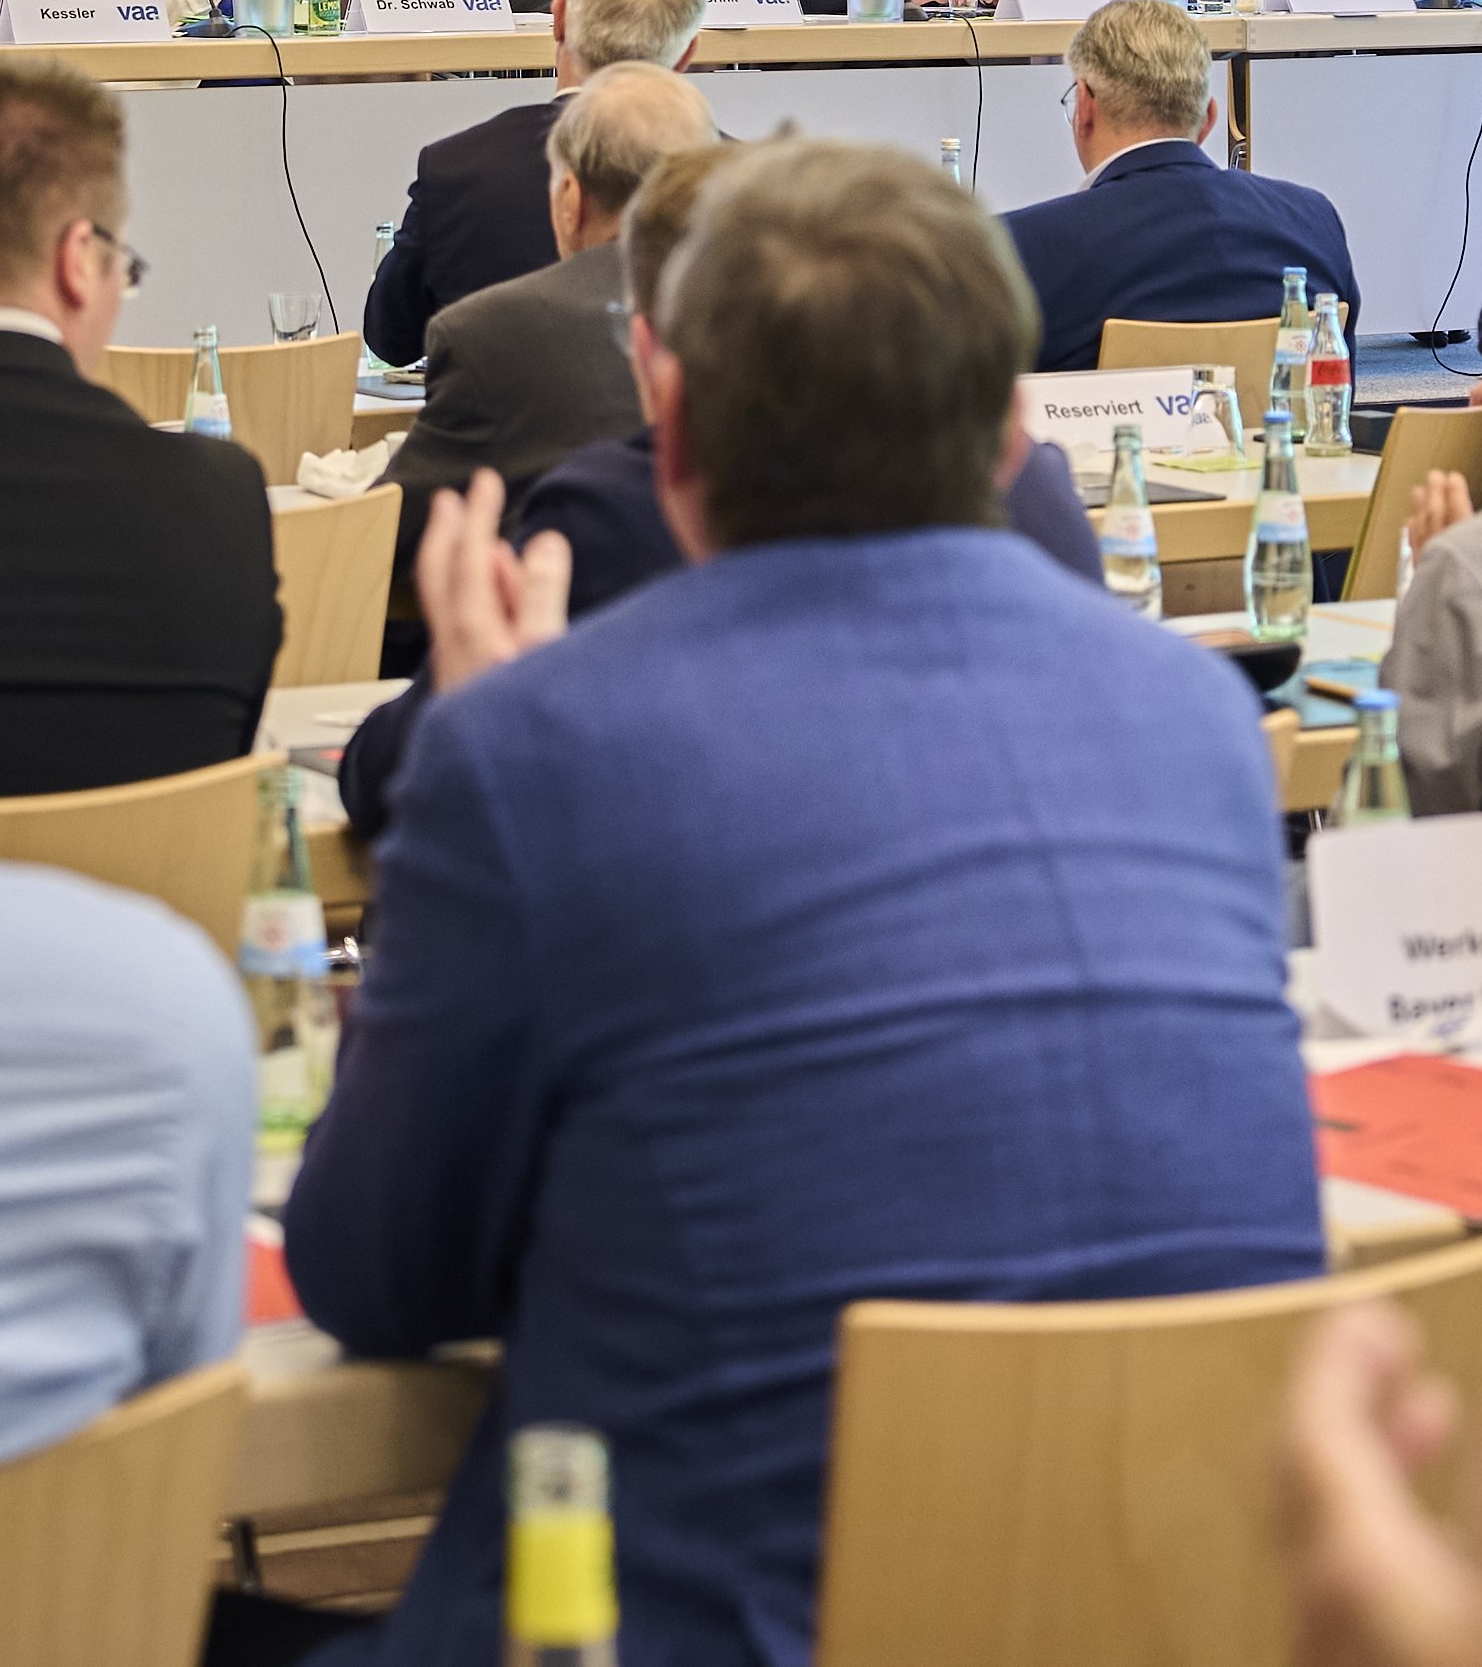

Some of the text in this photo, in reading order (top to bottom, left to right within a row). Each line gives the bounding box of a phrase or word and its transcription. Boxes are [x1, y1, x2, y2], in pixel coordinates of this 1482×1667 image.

[376, 0, 397, 10] Dr.
[40, 8, 95, 19] Kessler
[117, 5, 159, 20] vaa
[1045, 400, 1144, 419] Reserviert
